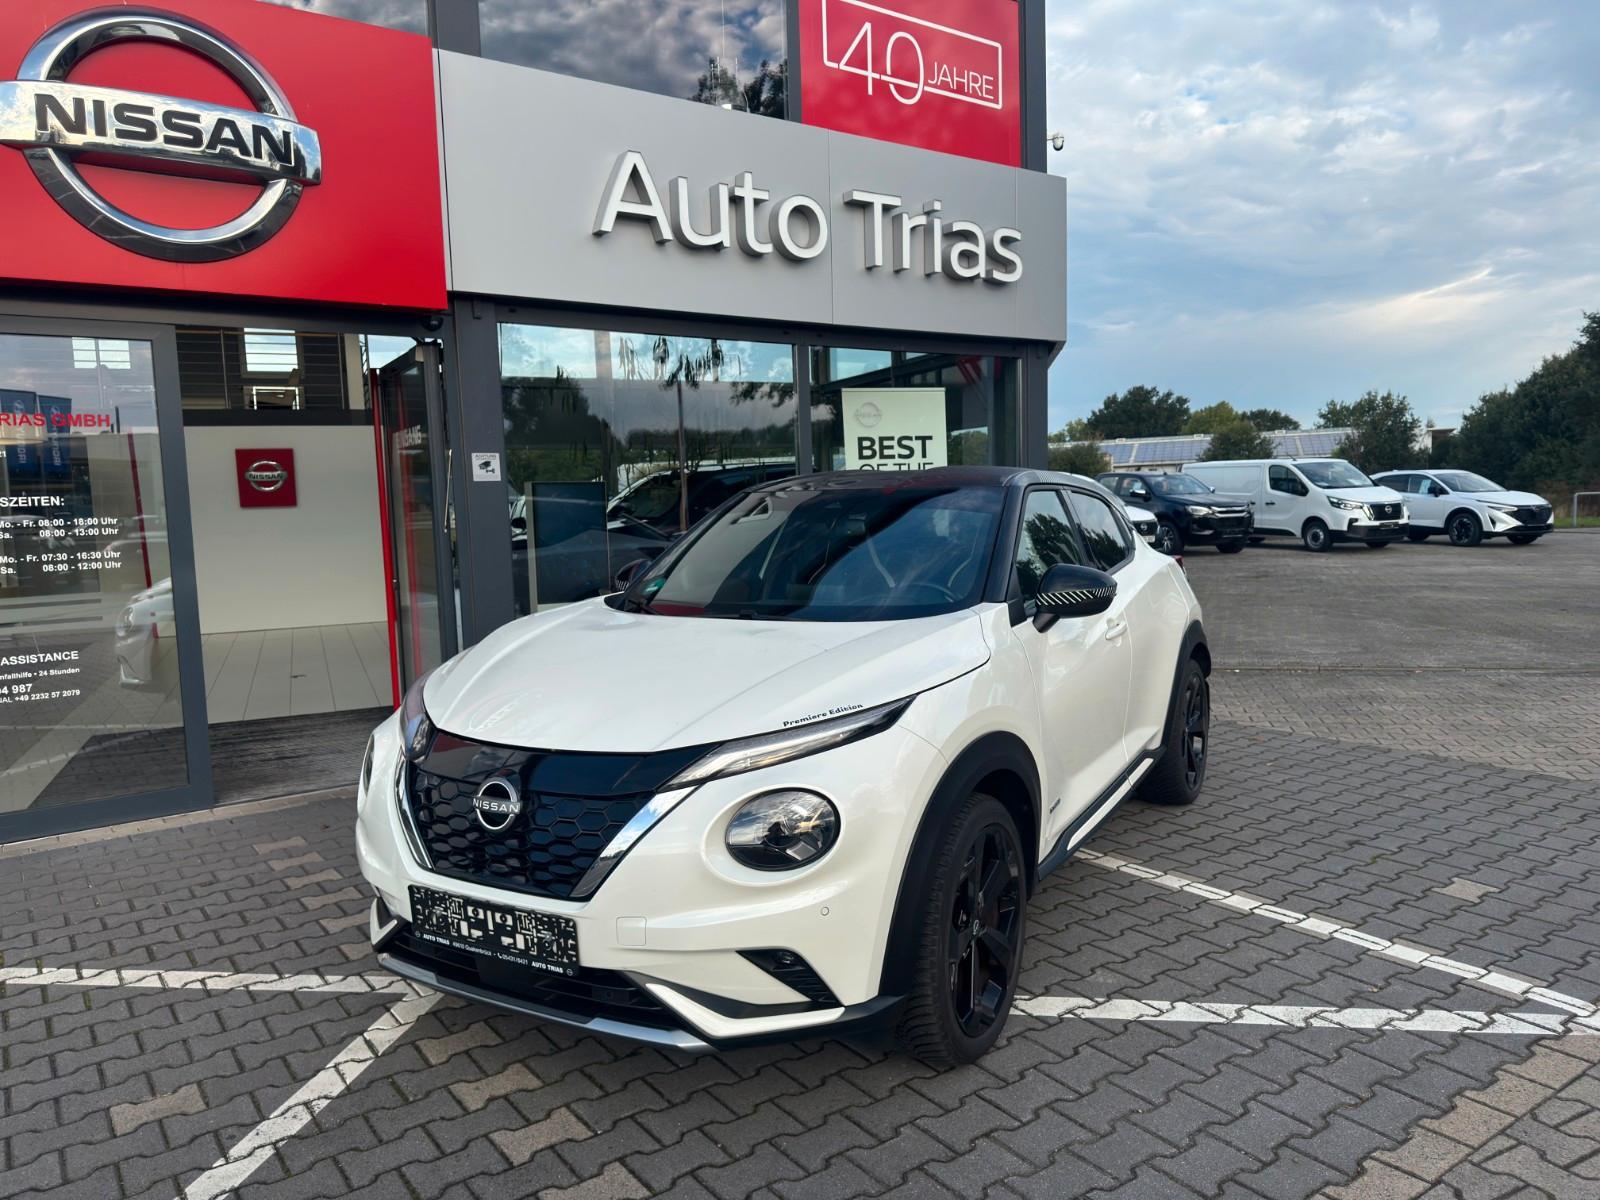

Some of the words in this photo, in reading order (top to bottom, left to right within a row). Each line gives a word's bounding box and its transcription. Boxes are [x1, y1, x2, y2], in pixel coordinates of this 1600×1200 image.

[838, 22, 924, 105] 40
[928, 61, 994, 99] JAHRE
[35, 94, 295, 166] NISSAN
[592, 150, 829, 262] Auto
[843, 189, 1023, 284] Trias
[51, 412, 111, 428] GMBH
[857, 435, 933, 460] BEST
[248, 473, 285, 481] NISSAN
[0, 495, 65, 507] SZEITEN:
[23, 519, 36, 528] Fr.
[38, 518, 65, 528] 08:00
[73, 516, 99, 526] 18:00
[100, 516, 118, 525] Uhr
[39, 528, 66, 538] 08:00
[75, 527, 100, 537] 13:00
[101, 527, 119, 536] Uhr
[0, 554, 18, 564] Mo.
[26, 554, 39, 563] Fr.
[41, 552, 68, 562] 07:30
[76, 551, 102, 560] 16:30
[103, 550, 121, 559] Uhr
[0, 566, 17, 575] Sa.
[42, 563, 69, 572] 08:00
[77, 560, 103, 570] 12:00
[104, 560, 122, 569] Uhr
[0, 650, 79, 666] ASSISTANCE
[38, 669, 48, 677] 24
[49, 668, 80, 676] Stunden
[11, 683, 33, 694] 987
[783, 712, 827, 727] Premiere
[829, 703, 864, 715] Edition
[472, 797, 519, 813] NISSAN
[531, 960, 547, 970] AUTO
[547, 964, 564, 974] TRIAS
